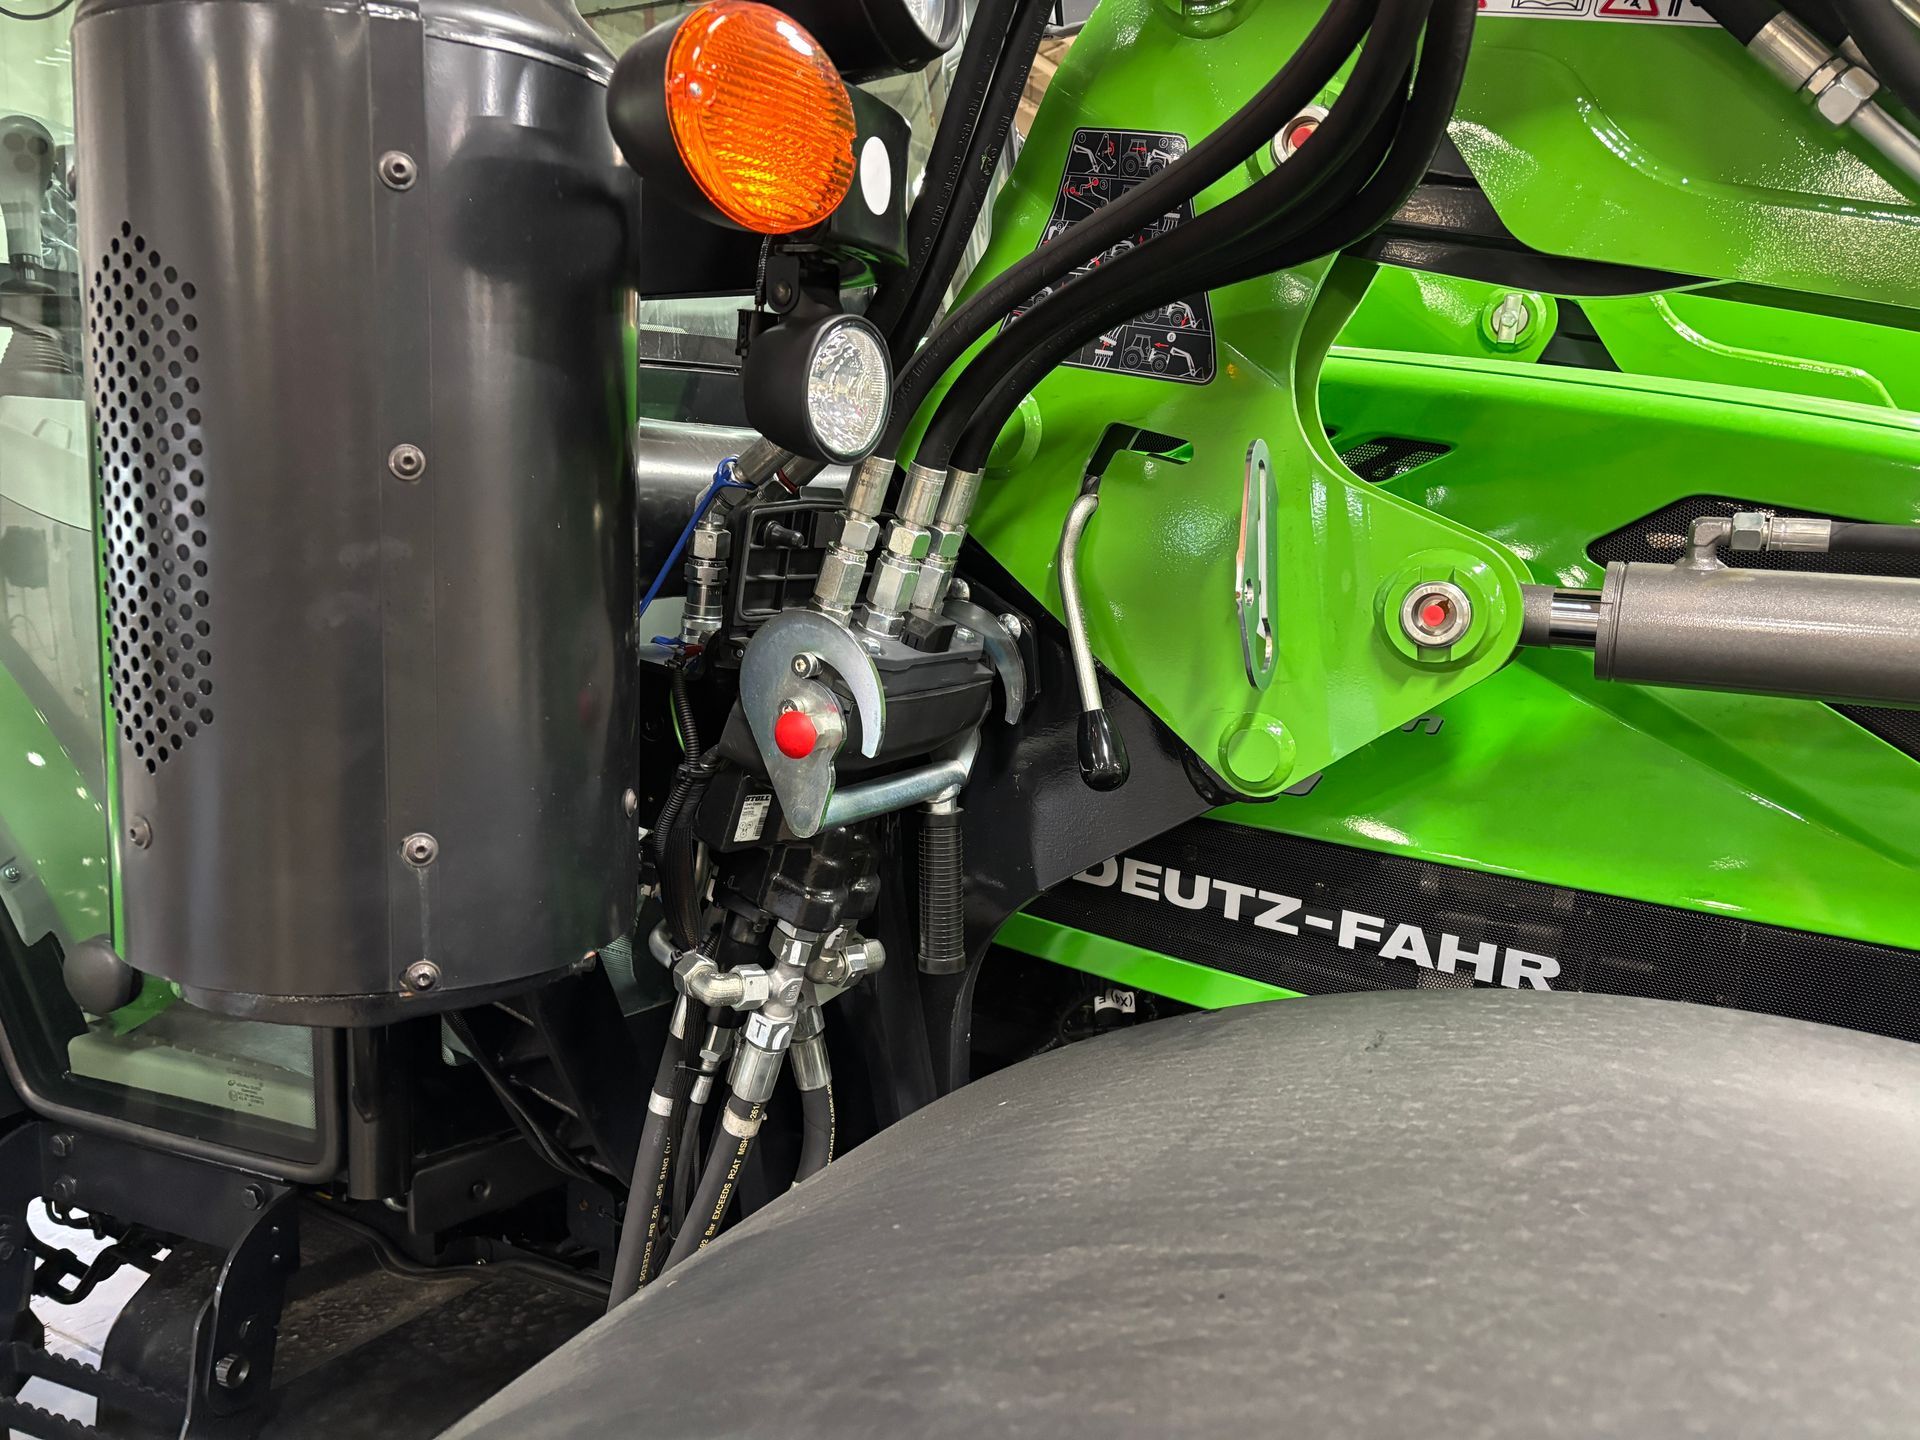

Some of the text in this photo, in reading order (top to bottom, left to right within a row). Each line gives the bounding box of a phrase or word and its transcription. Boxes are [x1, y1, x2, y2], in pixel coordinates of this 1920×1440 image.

[1073, 857, 1560, 991] DEUTZ-FAHR
[659, 1157, 670, 1180] DN16
[698, 1239, 709, 1251] 92
[705, 1223, 716, 1237] Bar
[711, 1182, 732, 1220] EXCEEDS
[727, 1158, 742, 1180] R2AT
[737, 1136, 750, 1155] MSH
[651, 1203, 660, 1219] 192
[648, 1222, 656, 1237] Bar
[639, 1241, 653, 1282] EXCEEDS
